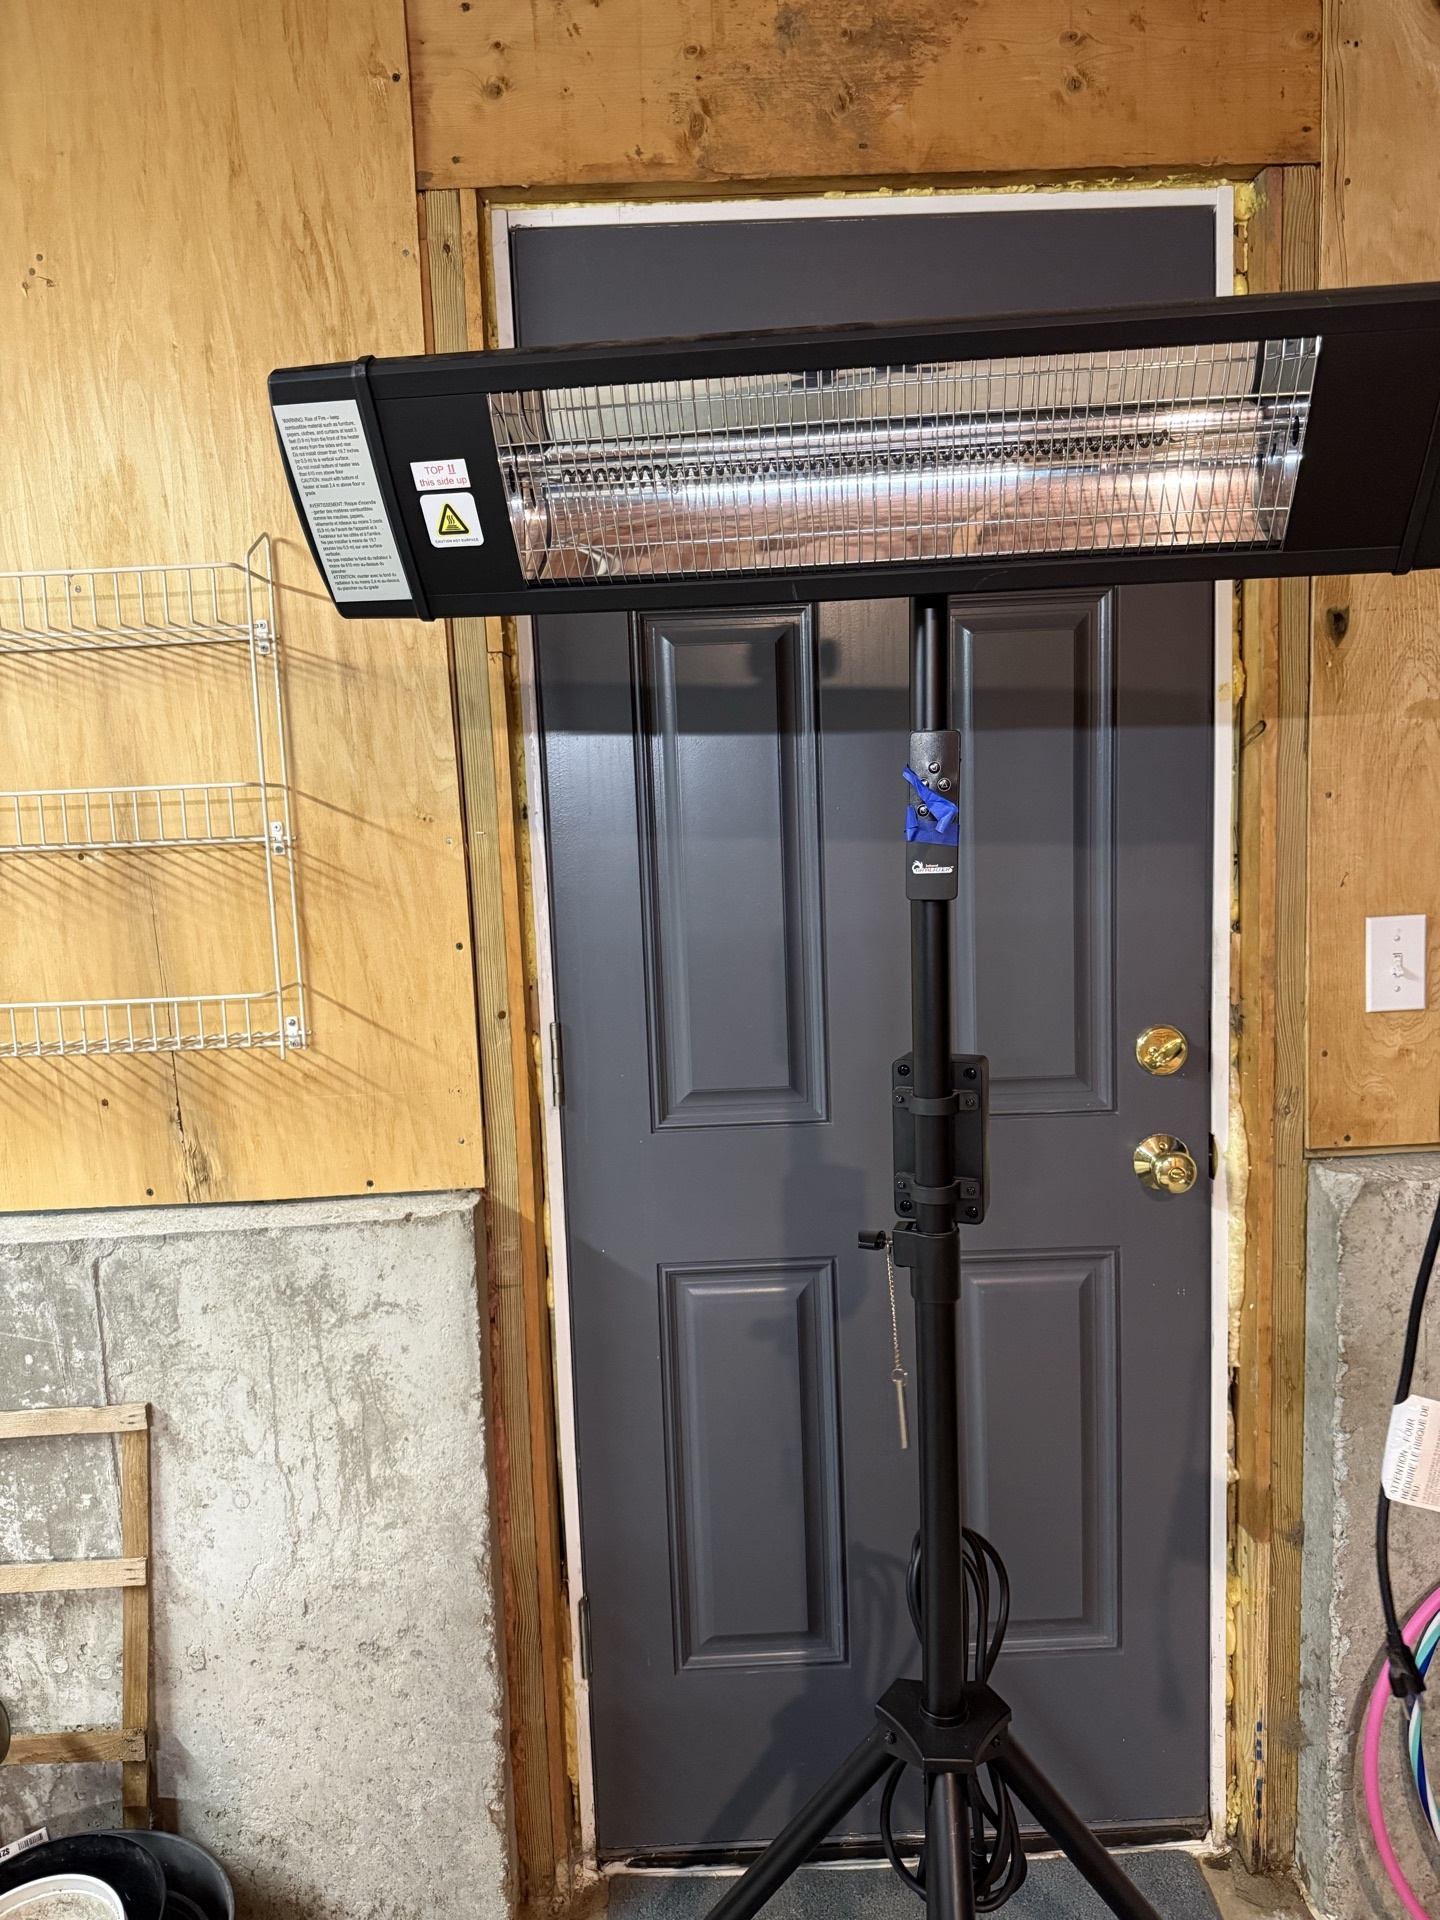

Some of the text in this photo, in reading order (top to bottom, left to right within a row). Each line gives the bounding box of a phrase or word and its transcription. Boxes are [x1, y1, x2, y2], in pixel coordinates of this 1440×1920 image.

[424, 466, 444, 474] TOP
[420, 479, 435, 487] this
[437, 477, 454, 485] side
[1420, 1405, 1429, 1417] DE
[1390, 1450, 1408, 1494] ATTENTION
